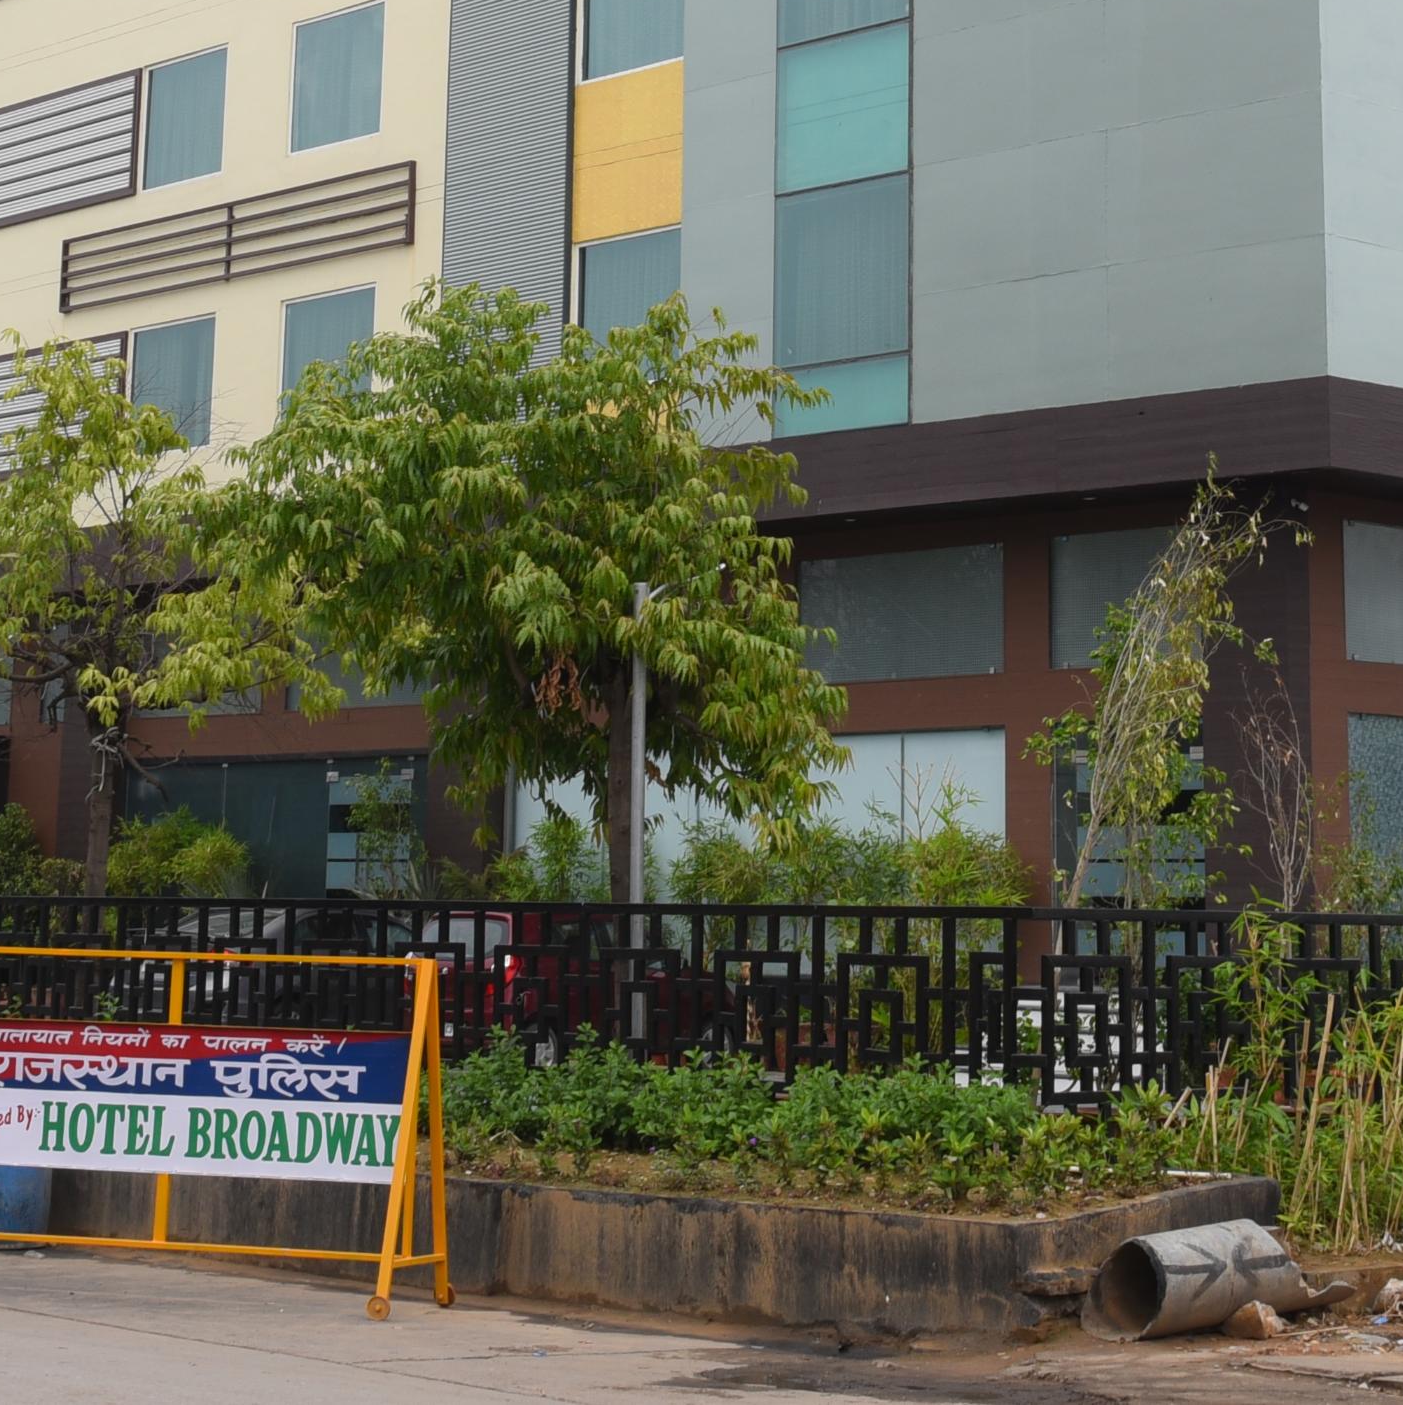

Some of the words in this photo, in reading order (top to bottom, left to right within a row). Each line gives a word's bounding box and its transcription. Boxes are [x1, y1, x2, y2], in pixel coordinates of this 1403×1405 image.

[81, 1025, 152, 1047] नियमों
[160, 1033, 190, 1050] का
[201, 1035, 272, 1053] पालन
[209, 1052, 367, 1101] पुलिस
[37, 1099, 176, 1157] HOTEL
[183, 1105, 401, 1168] BROADWAY
